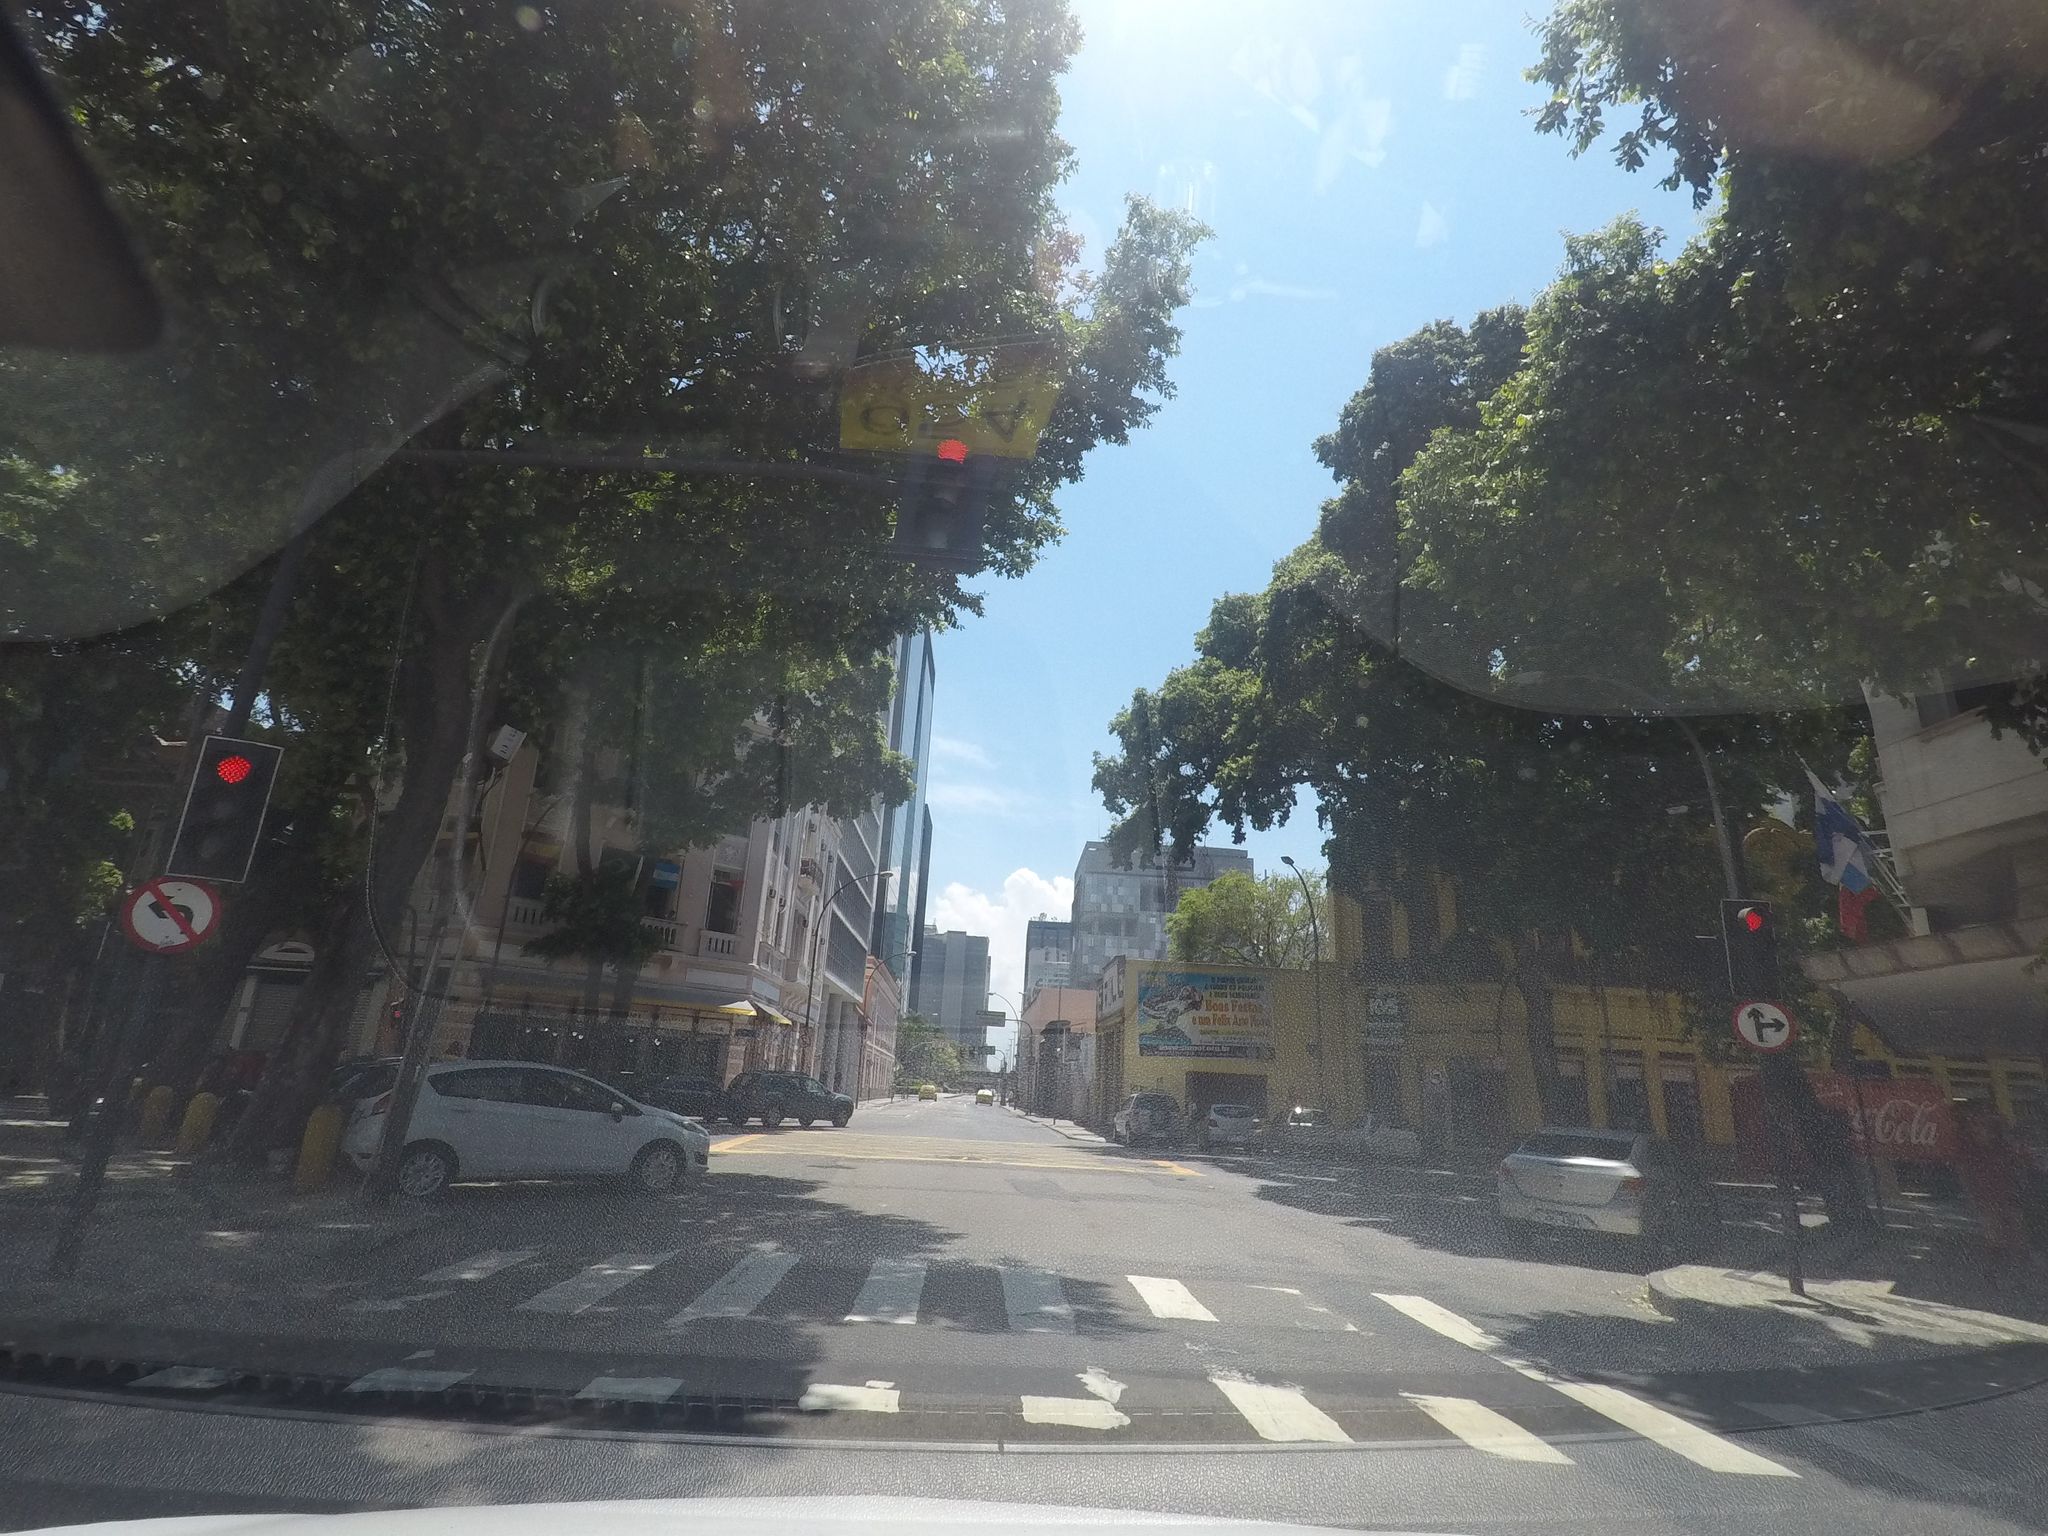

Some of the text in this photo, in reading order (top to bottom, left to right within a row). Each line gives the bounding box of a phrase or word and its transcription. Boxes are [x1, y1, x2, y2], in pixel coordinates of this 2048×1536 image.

[1205, 1000, 1229, 1012] Boas
[1198, 1016, 1211, 1025] um
[1233, 1015, 1249, 1026] Ano
